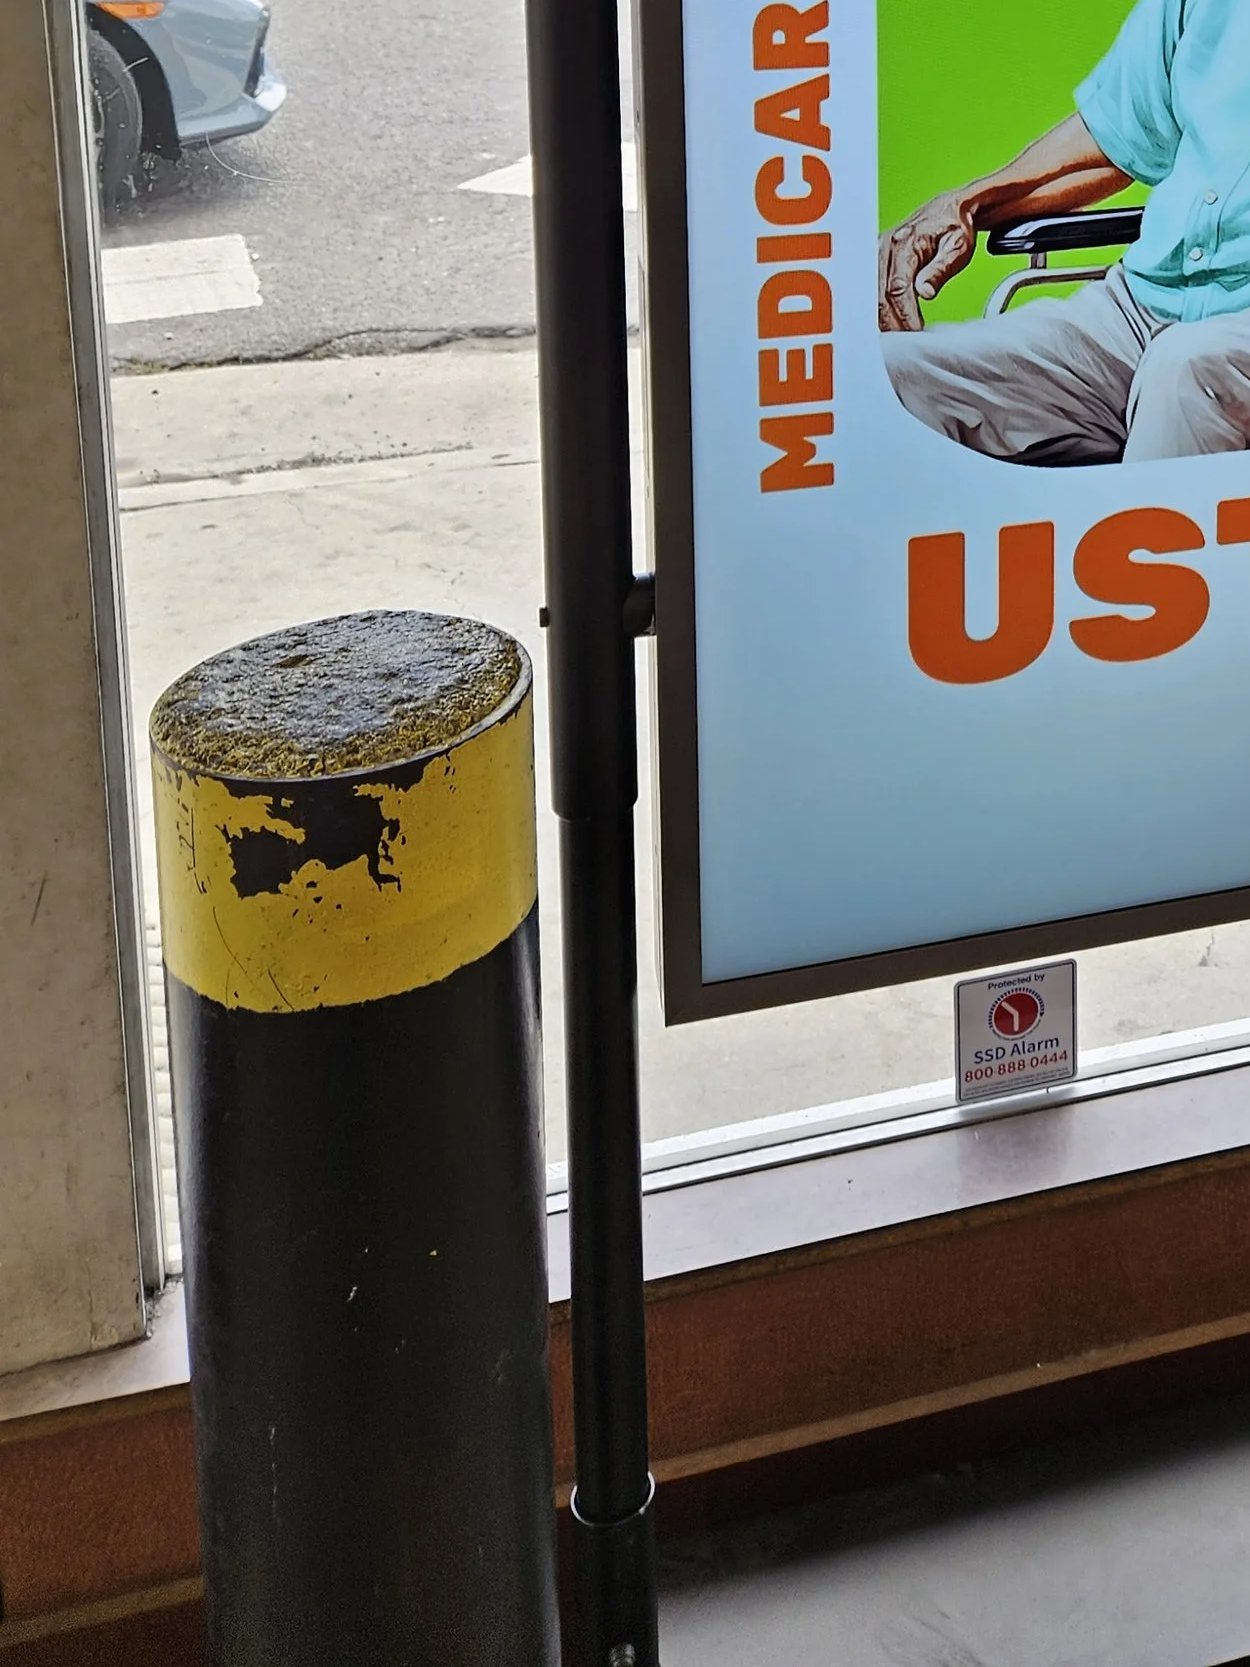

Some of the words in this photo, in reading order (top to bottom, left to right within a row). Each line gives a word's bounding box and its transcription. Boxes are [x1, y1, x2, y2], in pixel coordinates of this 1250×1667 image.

[988, 976, 1031, 990] Protected
[1033, 973, 1045, 982] by
[974, 1046, 1006, 1065] SSD
[1010, 1037, 1059, 1057] Alarm
